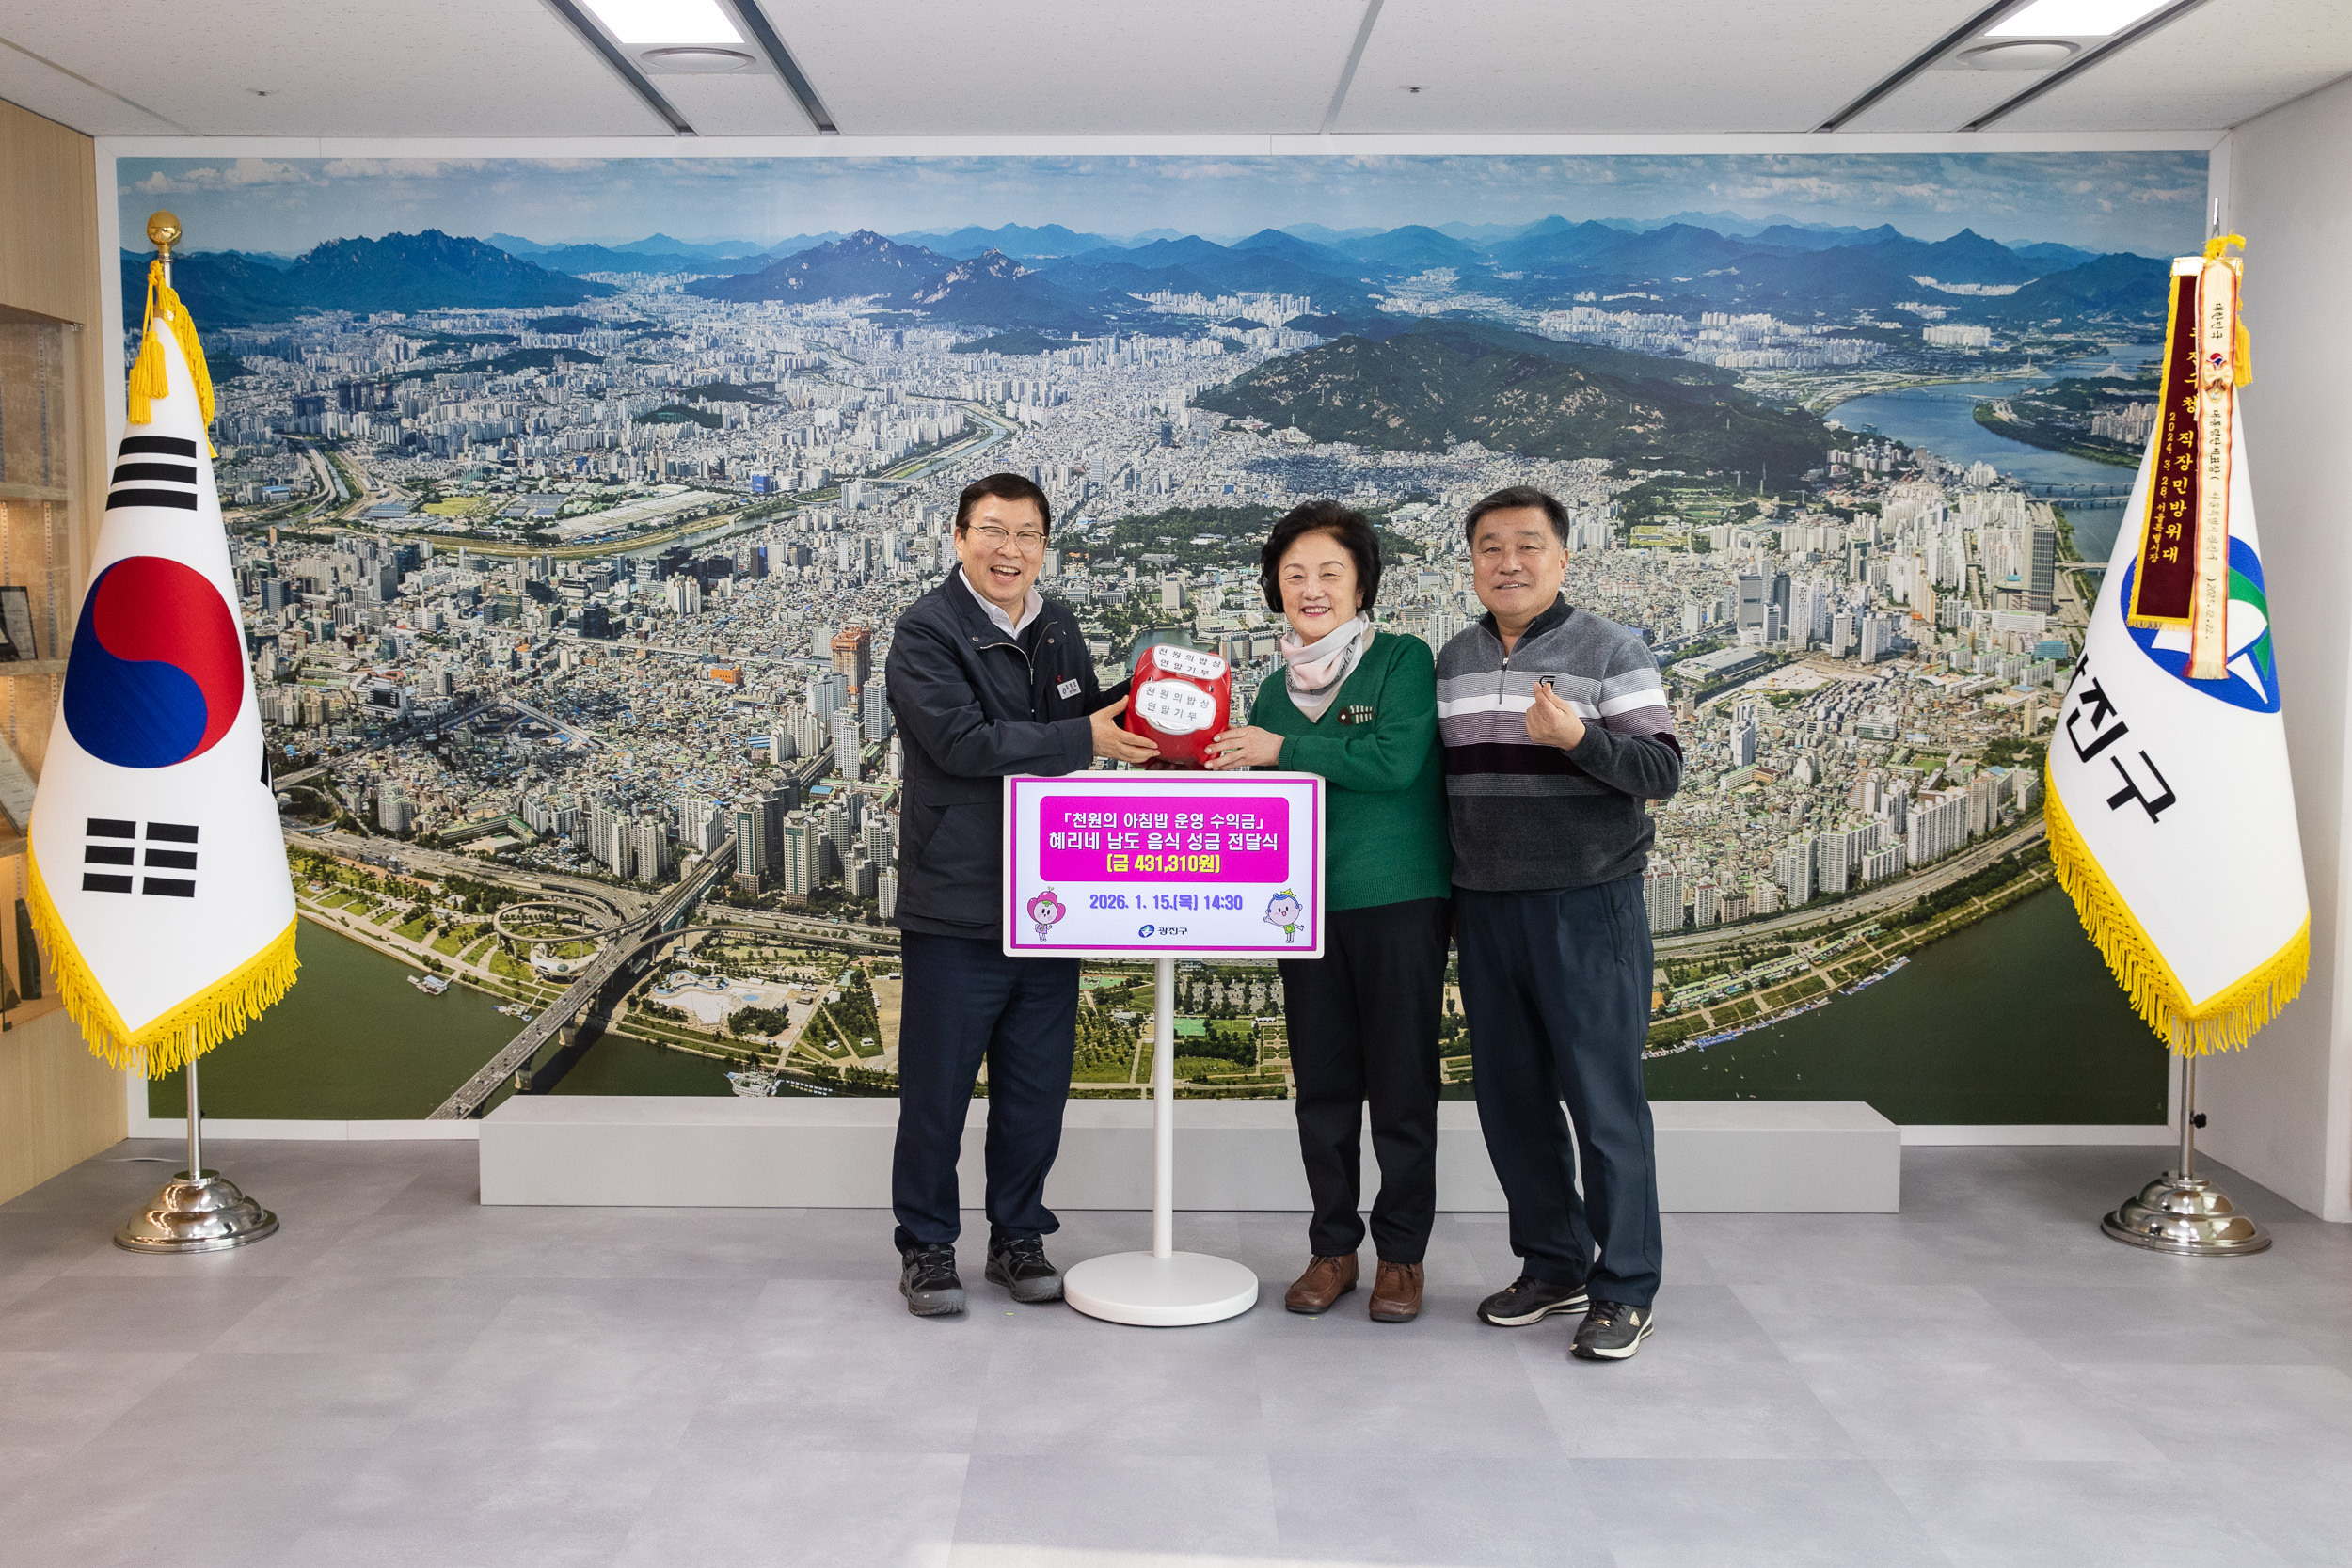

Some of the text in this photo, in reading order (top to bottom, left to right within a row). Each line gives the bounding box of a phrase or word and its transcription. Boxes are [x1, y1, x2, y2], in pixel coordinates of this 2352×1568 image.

[2211, 303, 2224, 339] 대한민국
[2166, 412, 2176, 454] 2024.
[2160, 477, 2169, 498] 28.
[2066, 653, 2176, 824] 진구
[1123, 813, 1169, 829] 아침밥
[1174, 813, 1204, 829] 운영
[1049, 832, 1279, 851] 혜리네 남도 음식 성금 전달식
[1089, 894, 1129, 910] 2026.
[1135, 895, 1147, 910] 1.
[1203, 895, 1244, 911] 14:30
[1158, 927, 1188, 936] 광진구
